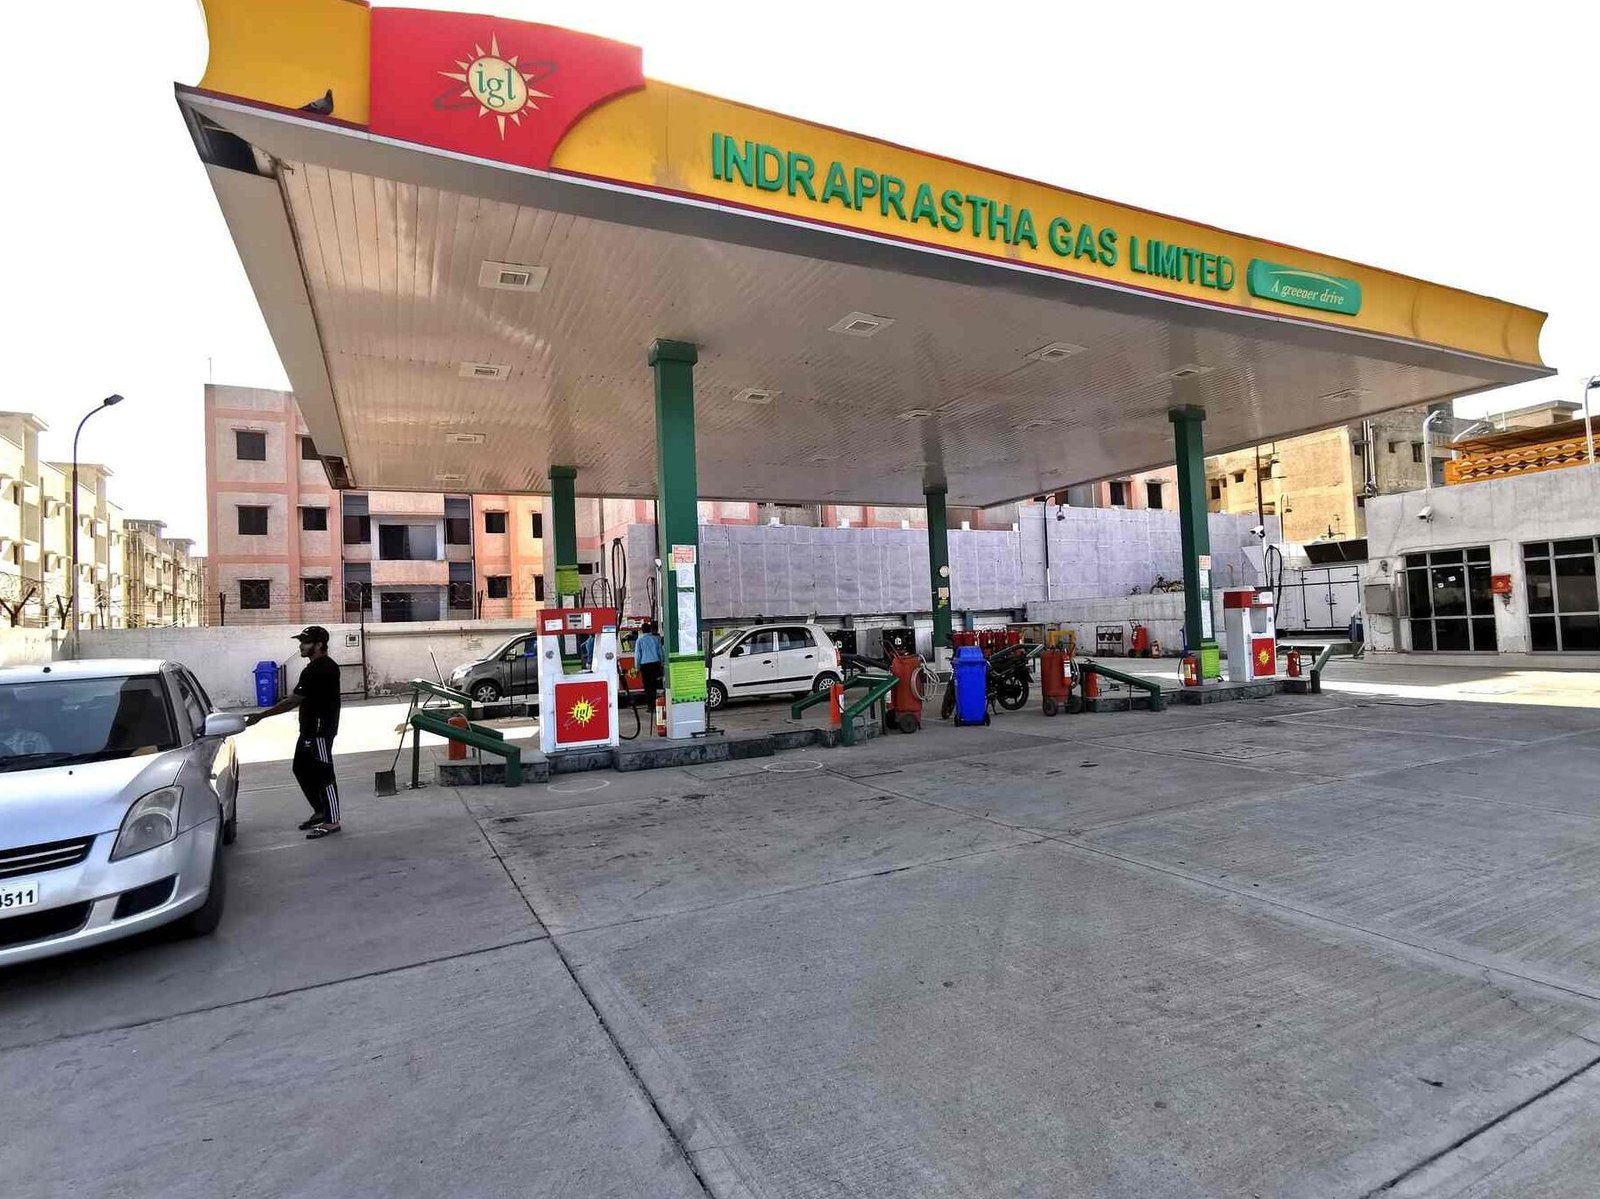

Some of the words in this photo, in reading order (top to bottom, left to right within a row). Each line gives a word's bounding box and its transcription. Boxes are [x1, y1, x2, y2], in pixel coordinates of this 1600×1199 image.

[476, 63, 517, 108] igl
[711, 132, 1038, 250] INDRAPRASTHA
[1049, 216, 1118, 267] GAS
[1129, 236, 1235, 291] LIMITED
[1271, 280, 1281, 293] A
[1281, 285, 1319, 301] greener
[1320, 288, 1345, 305] drive
[575, 705, 590, 721] igl
